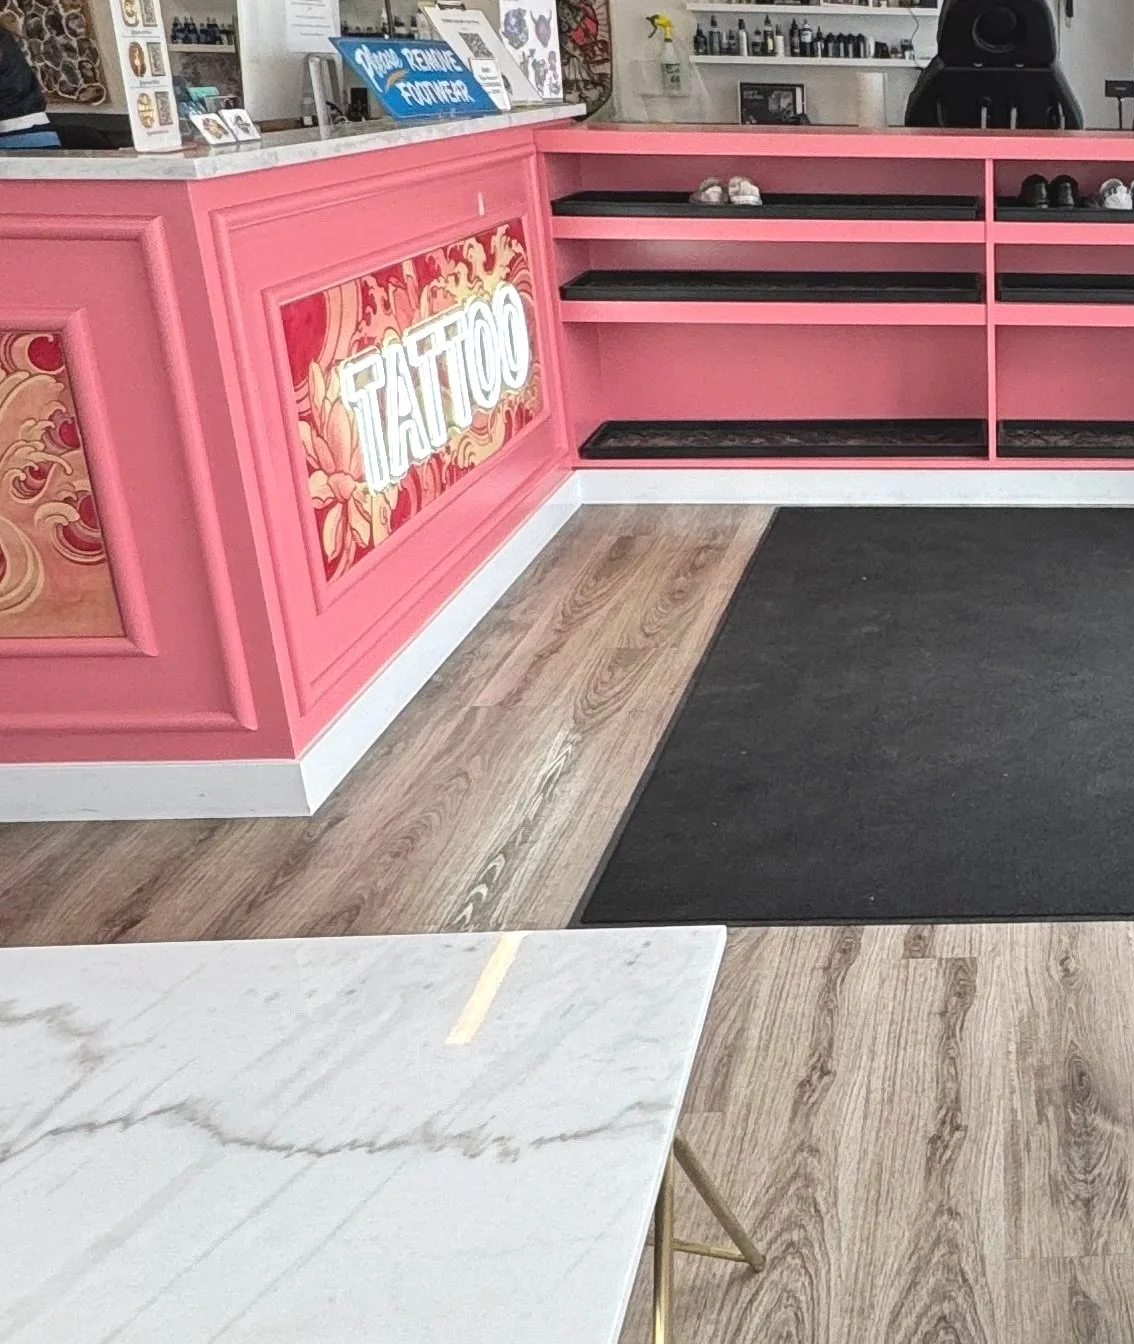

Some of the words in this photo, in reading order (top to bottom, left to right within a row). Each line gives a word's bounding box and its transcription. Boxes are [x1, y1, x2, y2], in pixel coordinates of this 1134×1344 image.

[401, 47, 463, 73] REMOVE
[395, 79, 475, 106] FOOTWEAR
[340, 279, 530, 495] TATTOO
